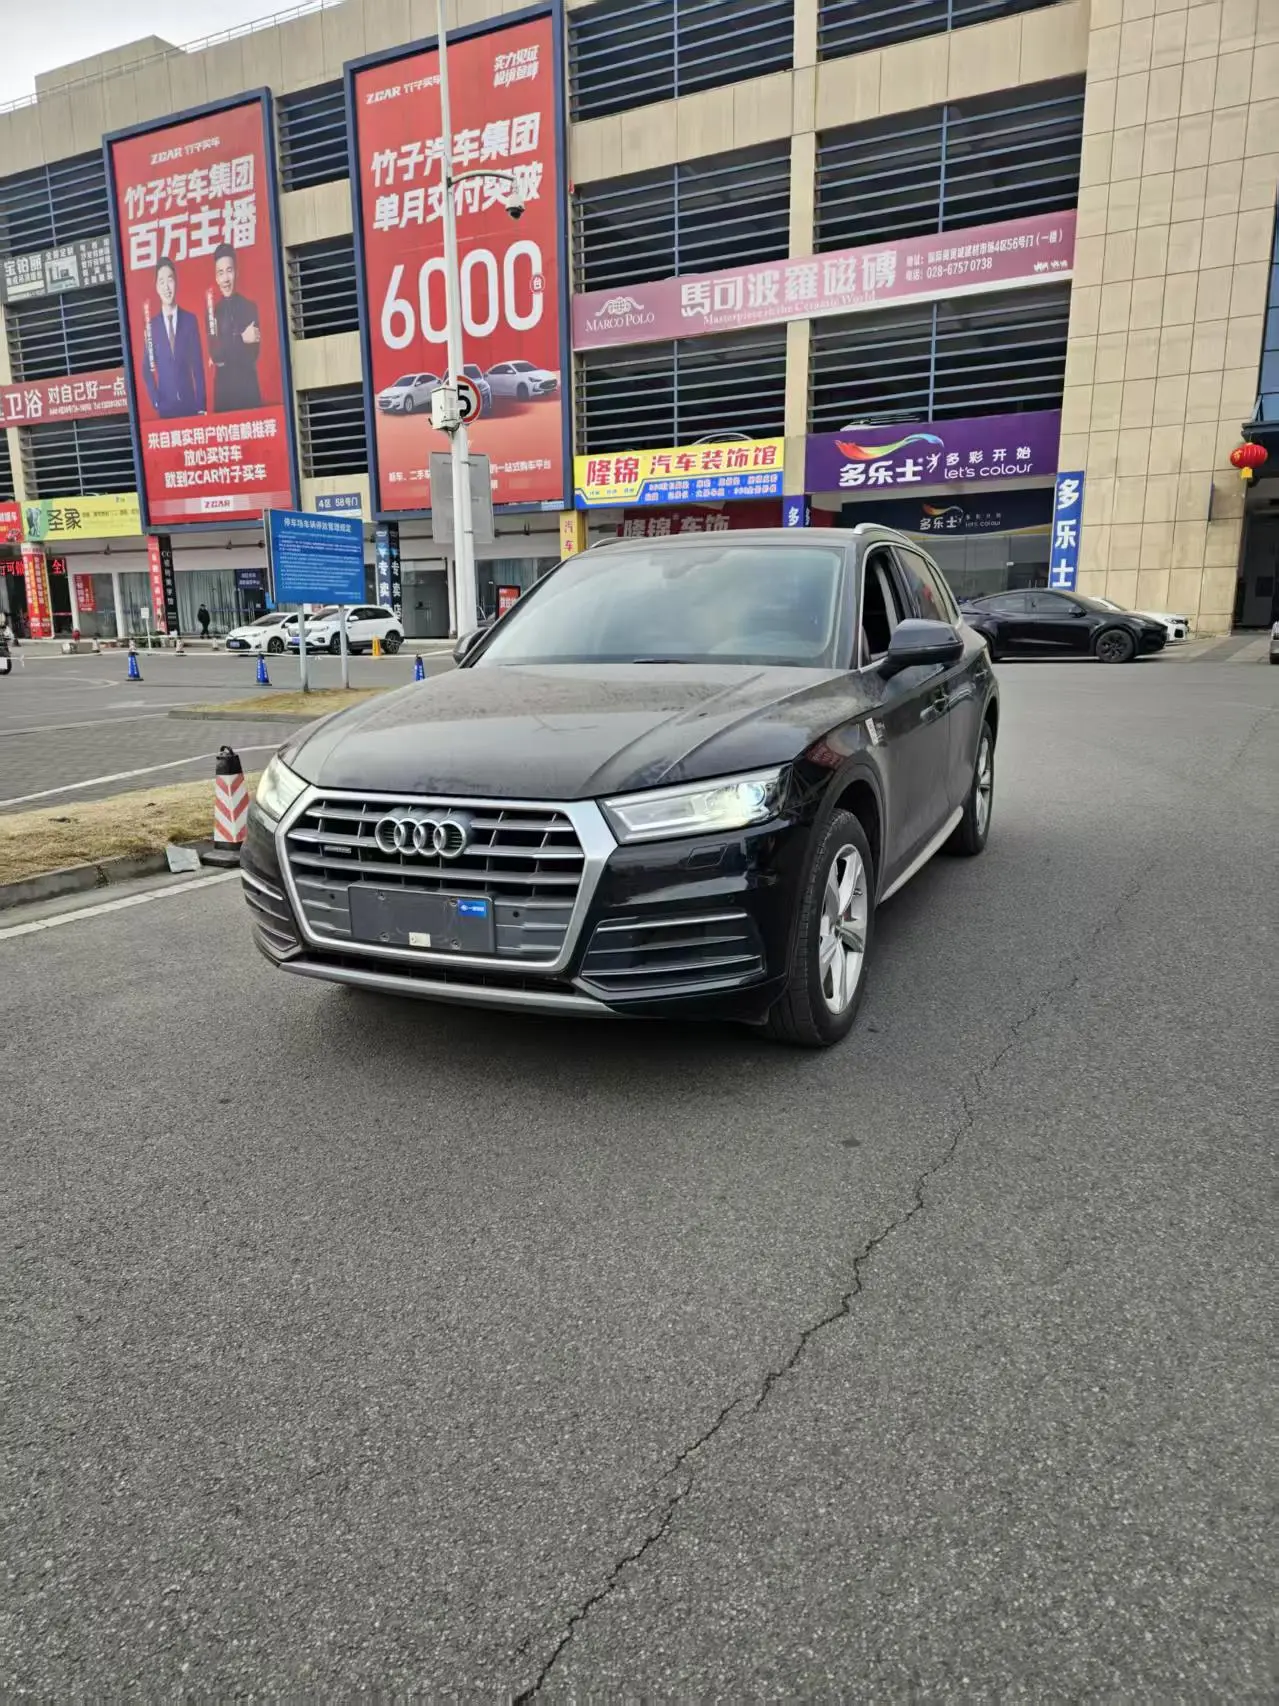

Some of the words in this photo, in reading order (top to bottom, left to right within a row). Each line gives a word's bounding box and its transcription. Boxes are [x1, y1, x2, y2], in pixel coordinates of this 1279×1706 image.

[365, 85, 401, 105] ZCAR
[150, 147, 183, 165] ZCAR
[371, 112, 541, 188] 竹子汽车集团
[125, 154, 255, 220] 竹子汽车集团
[373, 160, 543, 231] 单月交付突破
[128, 193, 257, 271] 百万主播
[381, 240, 543, 350] 6000
[585, 315, 624, 332] MARCO
[625, 312, 655, 327] POLO
[0, 388, 43, 421] 卫浴
[47, 376, 127, 405] 对自己好一点
[458, 384, 472, 417] 5
[148, 419, 278, 449] 来自真实用户的信赖推荐
[184, 444, 243, 467] 放心买好车
[586, 455, 640, 487] 隆锦
[650, 445, 777, 475] 汽车装饰馆
[945, 446, 1031, 466] 多彩开始
[838, 458, 923, 487] 多乐士
[944, 466, 976, 479] let's
[980, 463, 1033, 477] colour
[318, 498, 331, 508] 4区
[335, 496, 358, 507] 58号门
[47, 507, 82, 531] 圣象
[623, 517, 672, 537] 隆锦
[680, 513, 730, 534] 车饰
[788, 506, 800, 526] 多
[919, 515, 957, 531] 多乐士
[1052, 478, 1080, 587] 多乐士
